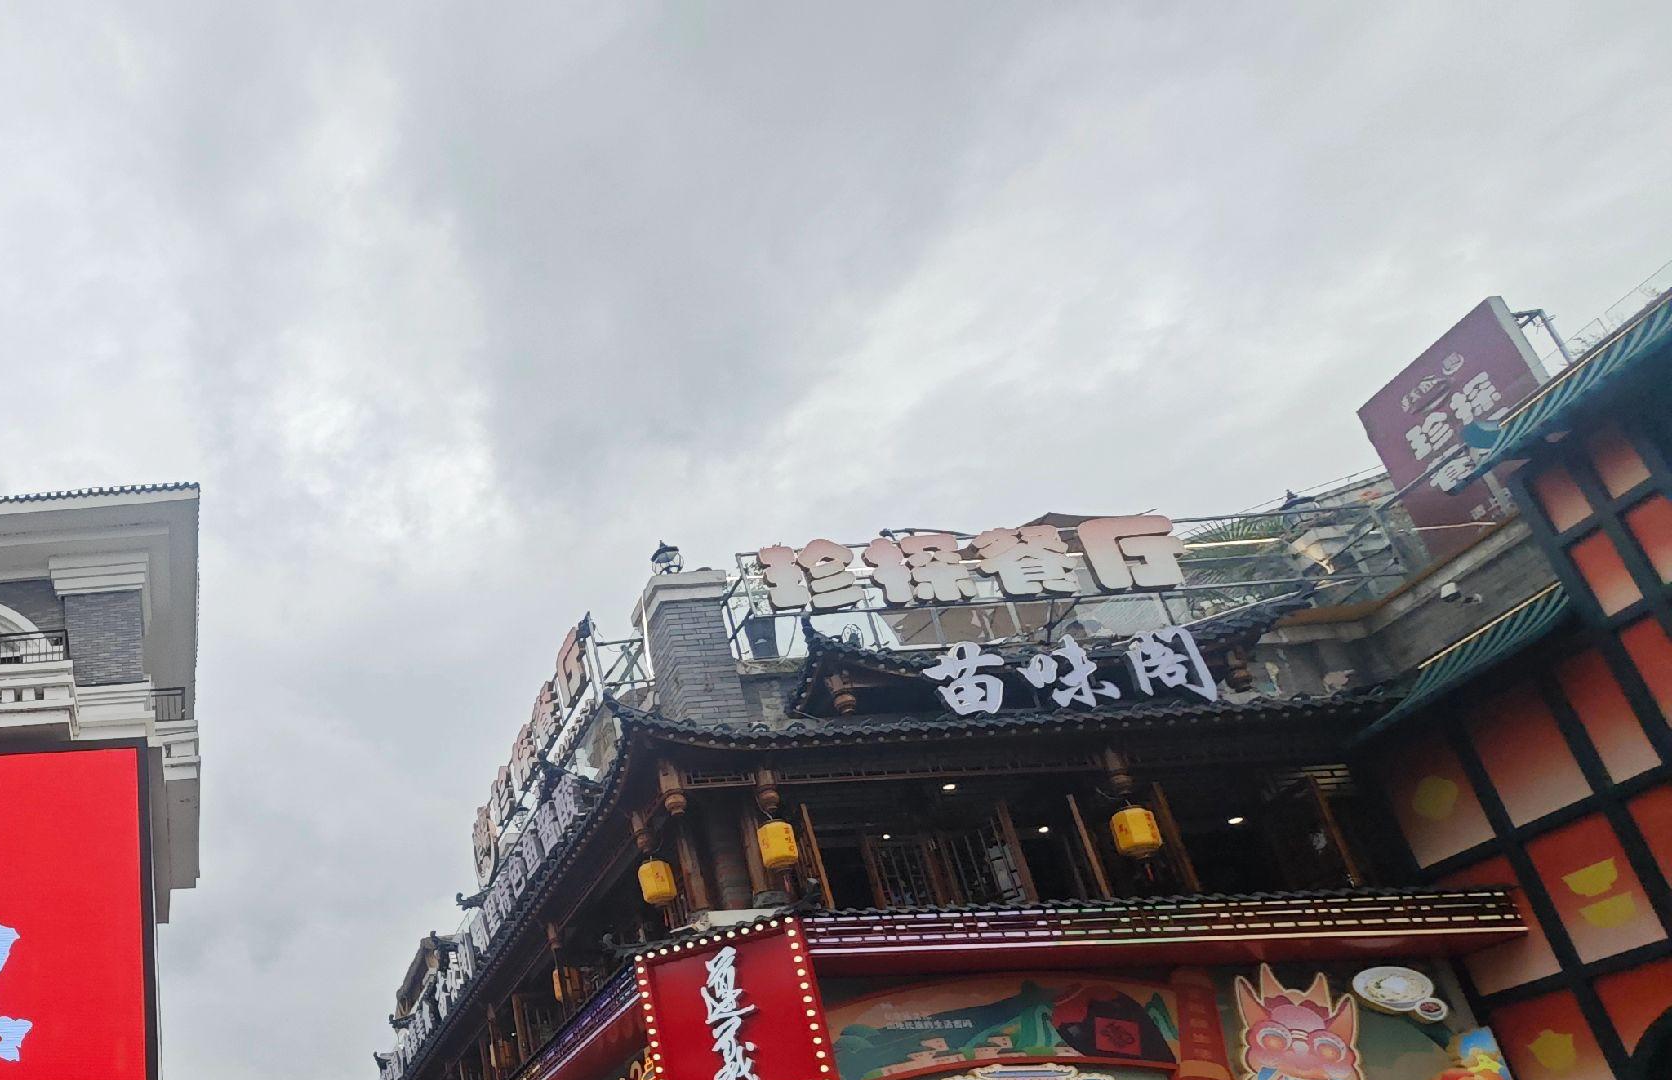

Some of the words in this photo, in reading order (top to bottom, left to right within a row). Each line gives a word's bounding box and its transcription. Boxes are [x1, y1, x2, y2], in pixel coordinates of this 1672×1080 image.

[757, 514, 1192, 610] 珍探餐厅
[924, 625, 1217, 715] 苗味阁
